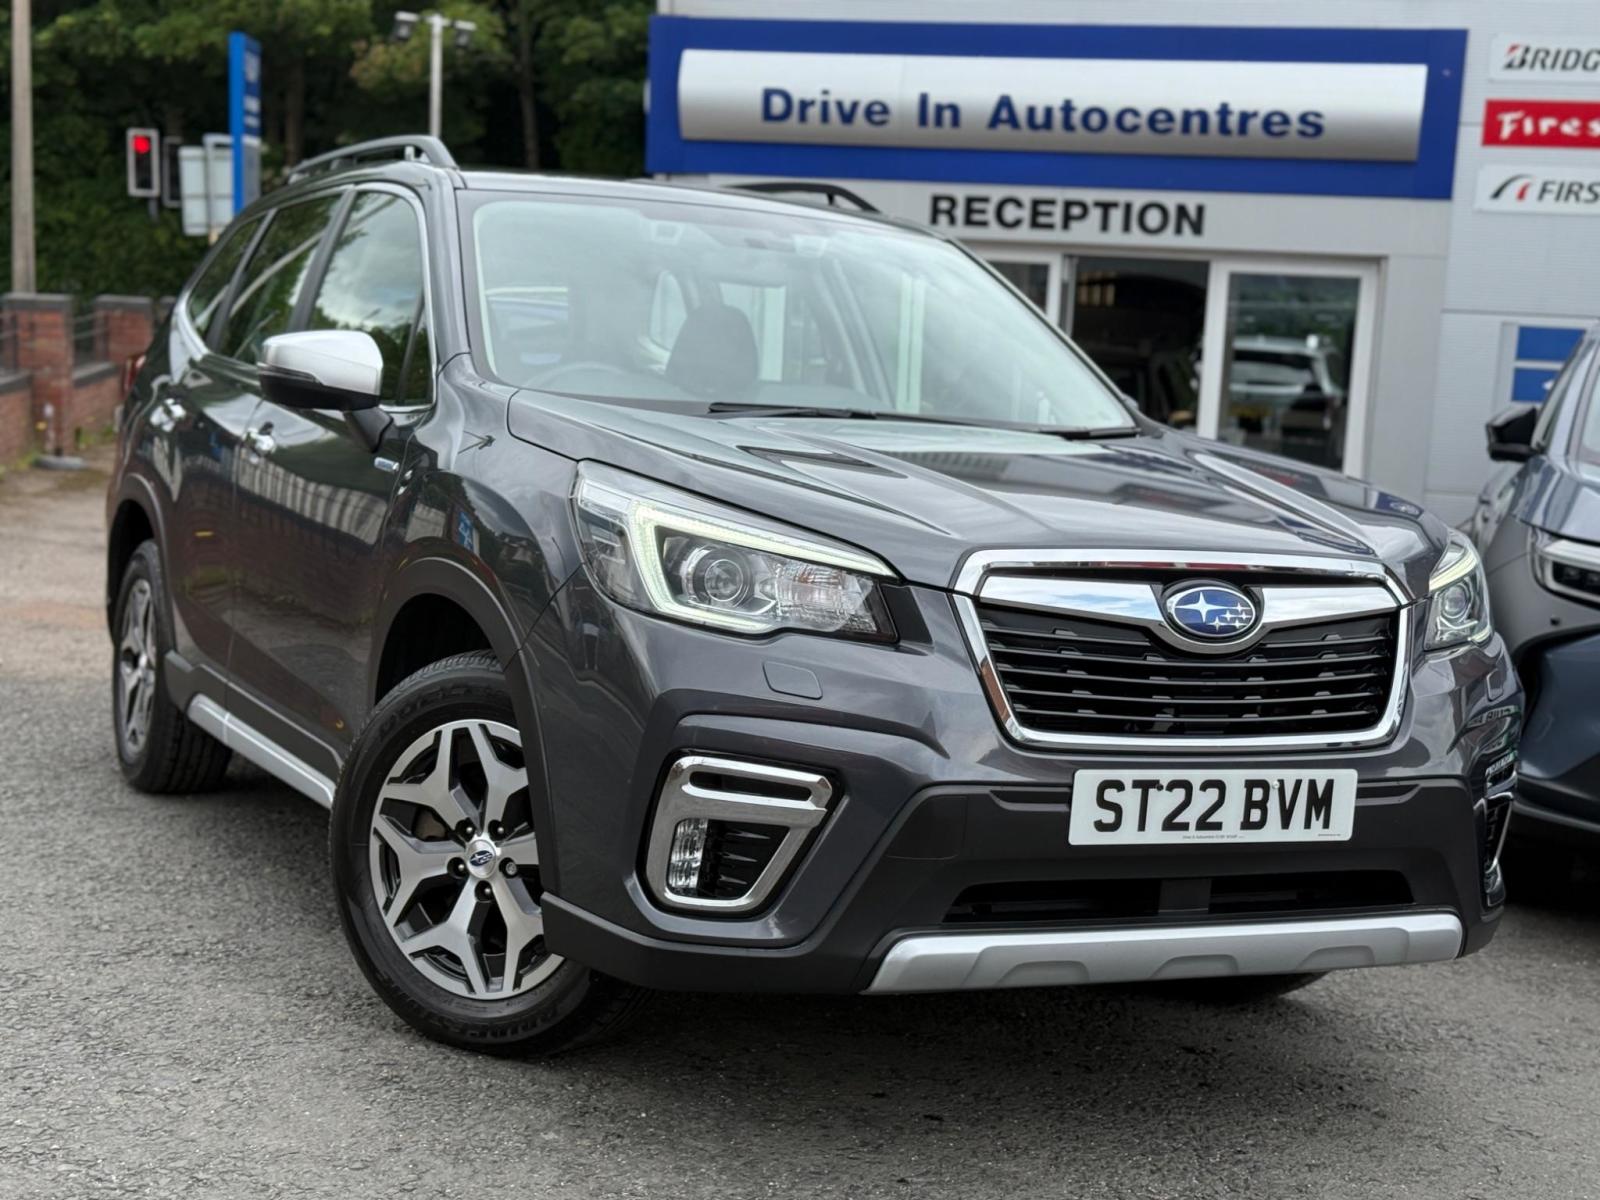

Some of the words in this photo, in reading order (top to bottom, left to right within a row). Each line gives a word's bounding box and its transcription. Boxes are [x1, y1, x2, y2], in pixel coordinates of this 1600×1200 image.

[1503, 43, 1600, 72] BRIDG
[762, 88, 890, 127] Drive
[917, 92, 961, 129] In
[987, 94, 1326, 139] Autocentres
[929, 193, 1206, 237] RECEPTION
[1093, 779, 1226, 832] ST22
[1240, 778, 1334, 830] BVM
